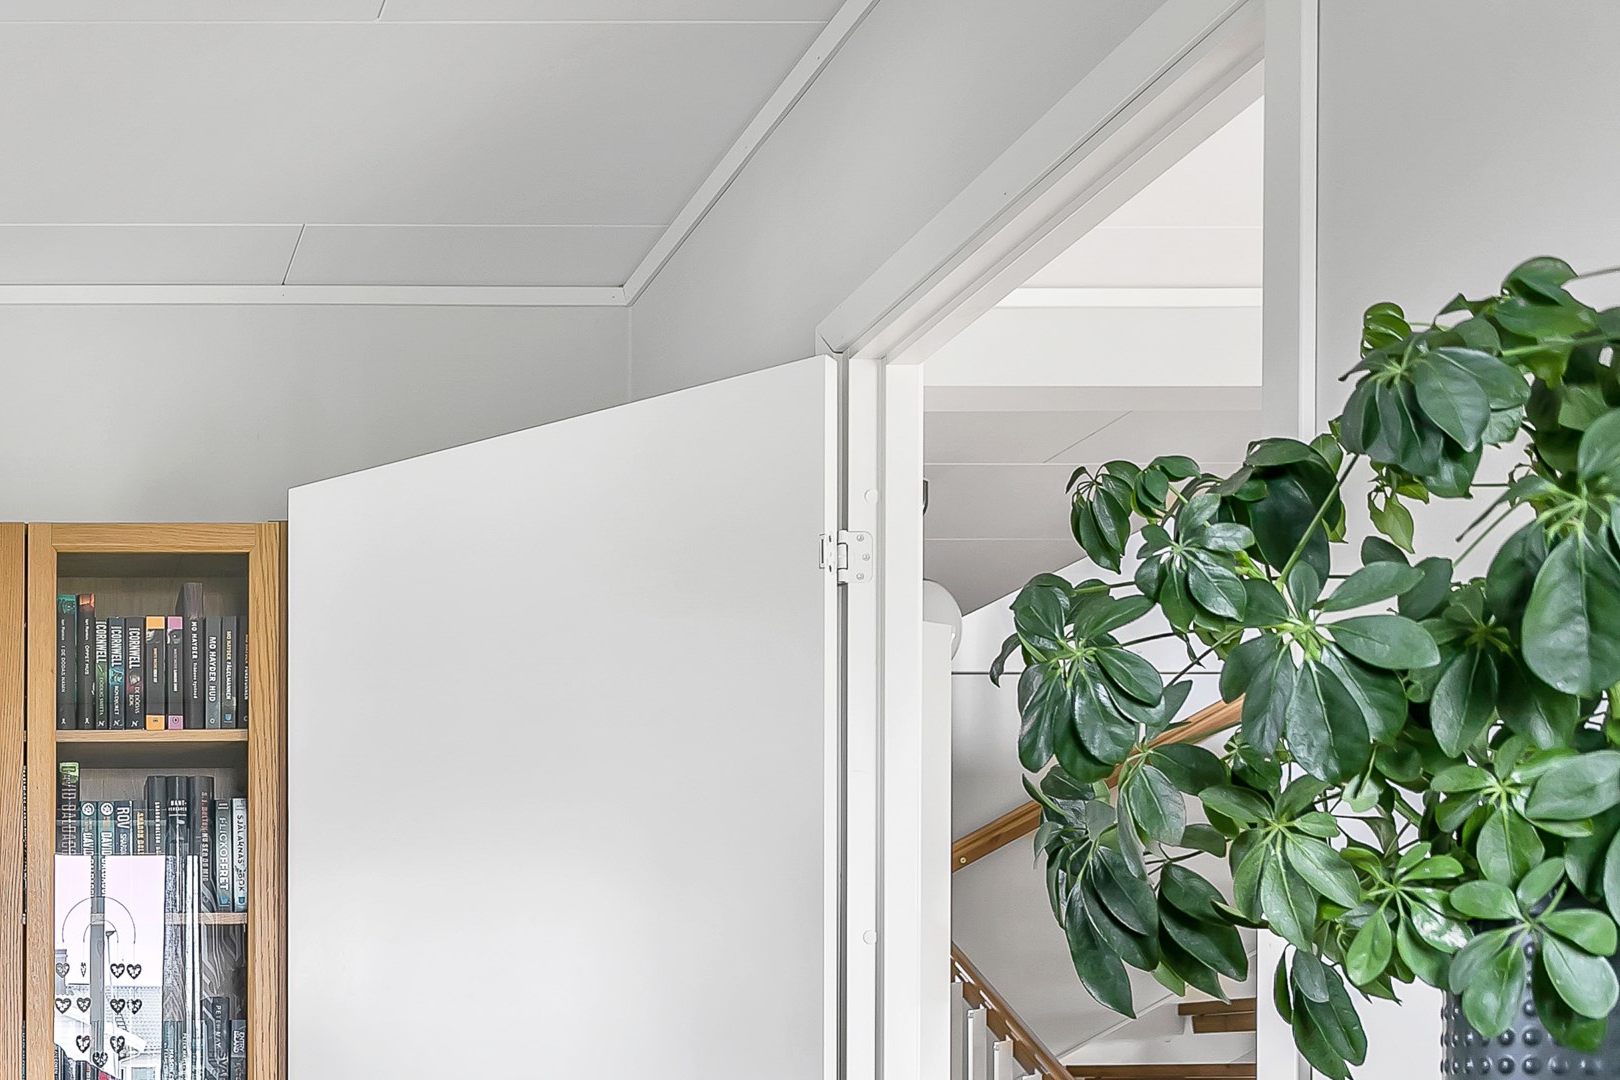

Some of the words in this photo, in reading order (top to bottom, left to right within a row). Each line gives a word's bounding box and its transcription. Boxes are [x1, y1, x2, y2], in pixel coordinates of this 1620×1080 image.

[96, 625, 107, 664] CORNWELL
[111, 629, 123, 667] CORNWELL
[129, 631, 141, 669] CORNWELL
[117, 807, 130, 829] ROV
